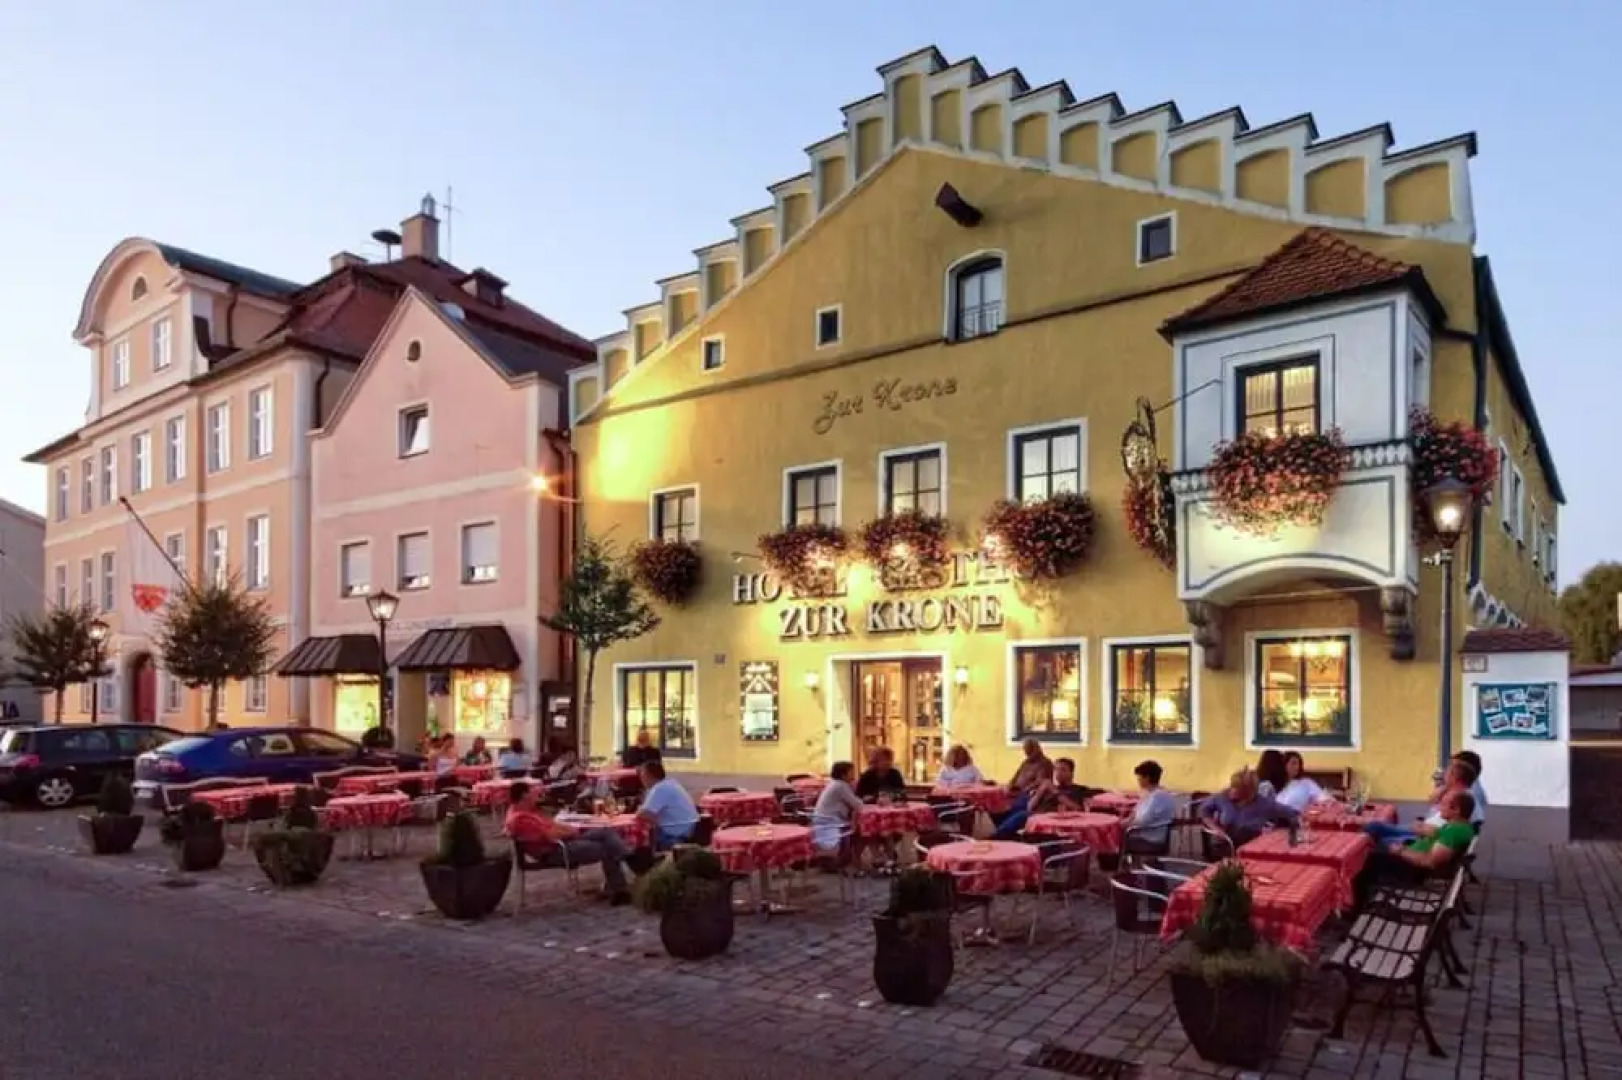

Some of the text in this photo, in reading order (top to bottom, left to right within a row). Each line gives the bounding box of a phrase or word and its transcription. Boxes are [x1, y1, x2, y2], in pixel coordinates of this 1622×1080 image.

[812, 377, 958, 436] Zur Krone
[780, 594, 1004, 640] ZUR KRONE
